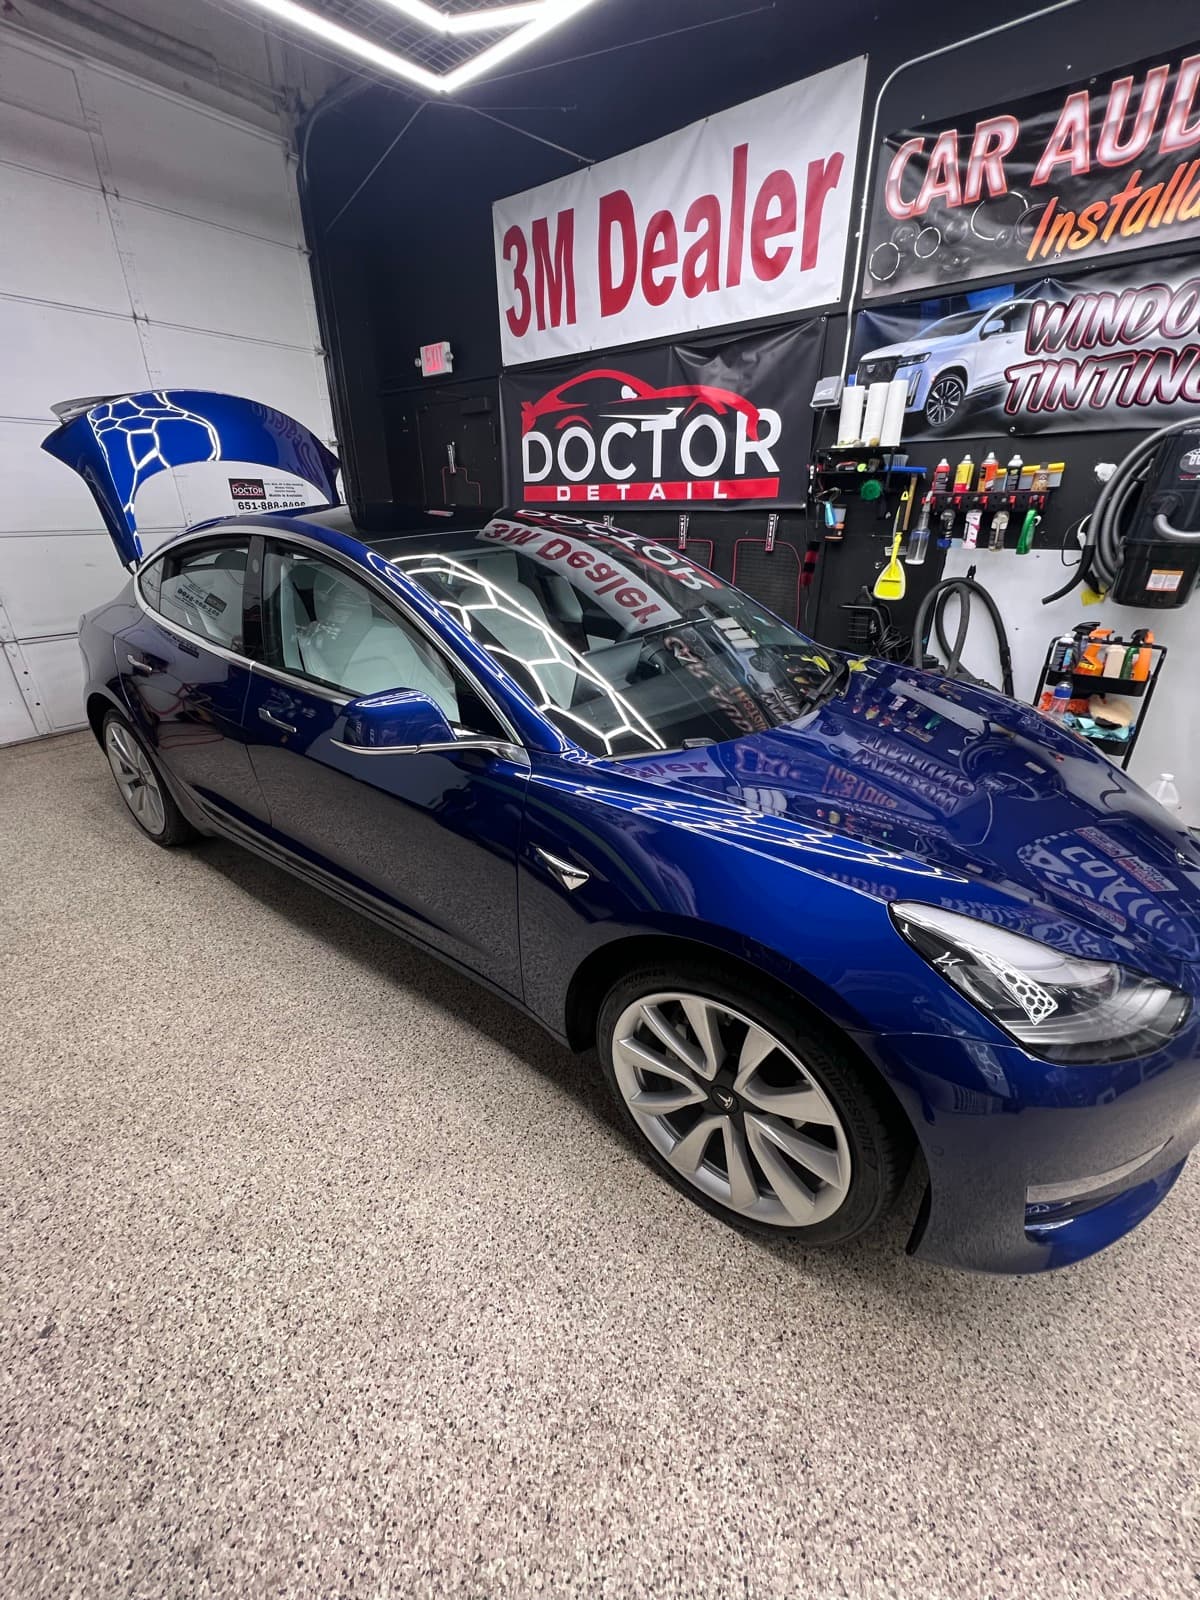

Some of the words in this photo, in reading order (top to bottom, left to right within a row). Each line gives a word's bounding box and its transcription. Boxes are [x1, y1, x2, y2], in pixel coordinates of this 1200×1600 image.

[885, 115, 1019, 220] CAR
[503, 208, 576, 337] 3M
[599, 143, 844, 317] Dealer
[424, 344, 444, 372] EXIT
[522, 408, 782, 483] DOCTOR
[232, 487, 263, 495] DOCTOR
[556, 482, 727, 501] DETAIL
